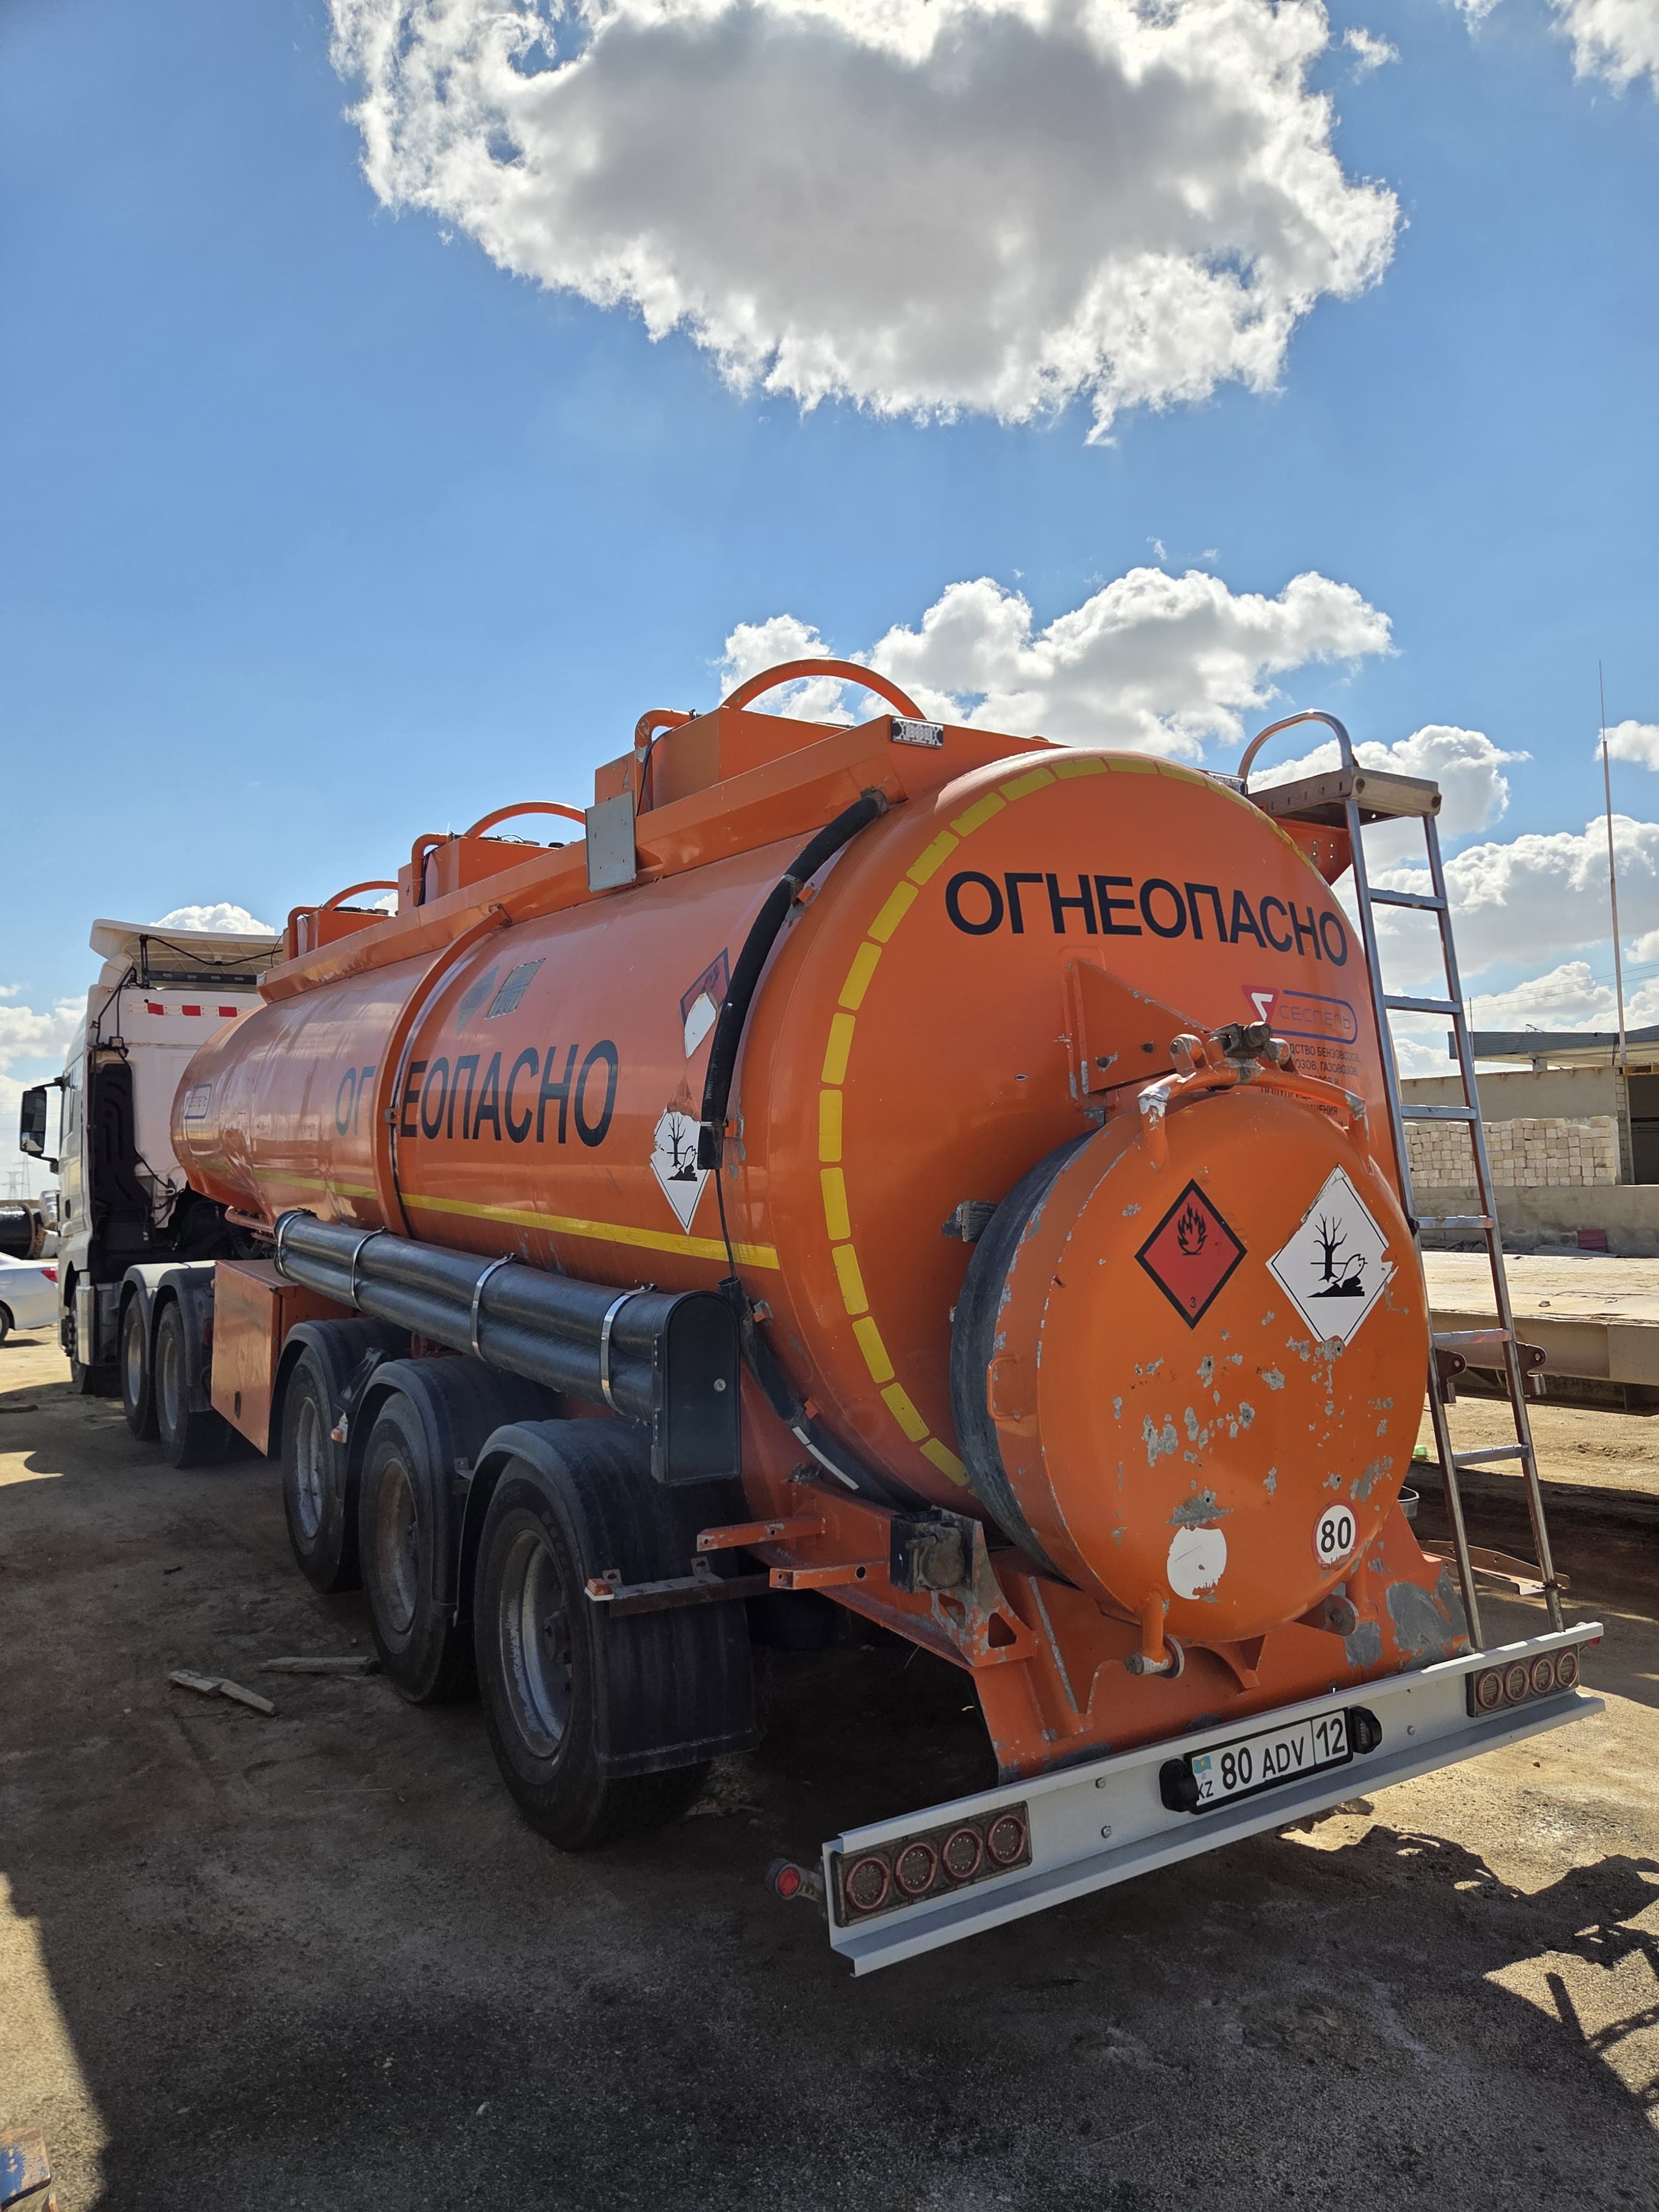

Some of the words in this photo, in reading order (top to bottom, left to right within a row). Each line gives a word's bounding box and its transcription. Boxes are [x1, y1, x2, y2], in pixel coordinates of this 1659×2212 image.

[945, 871, 1347, 967] ОГНЕОПАСНО
[1279, 1004, 1352, 1030] СЕСПЕЛЬ
[1289, 1043, 1316, 1056] ДСТВО
[1295, 1058, 1319, 1072] ОЗОВ,
[335, 1040, 619, 1147] ОГЕОПАСНО
[1190, 1296, 1196, 1308] 3
[1320, 1516, 1352, 1553] 80
[1220, 1746, 1253, 1790] 80
[1262, 1736, 1305, 1779] ADV
[1316, 1718, 1345, 1757] 12
